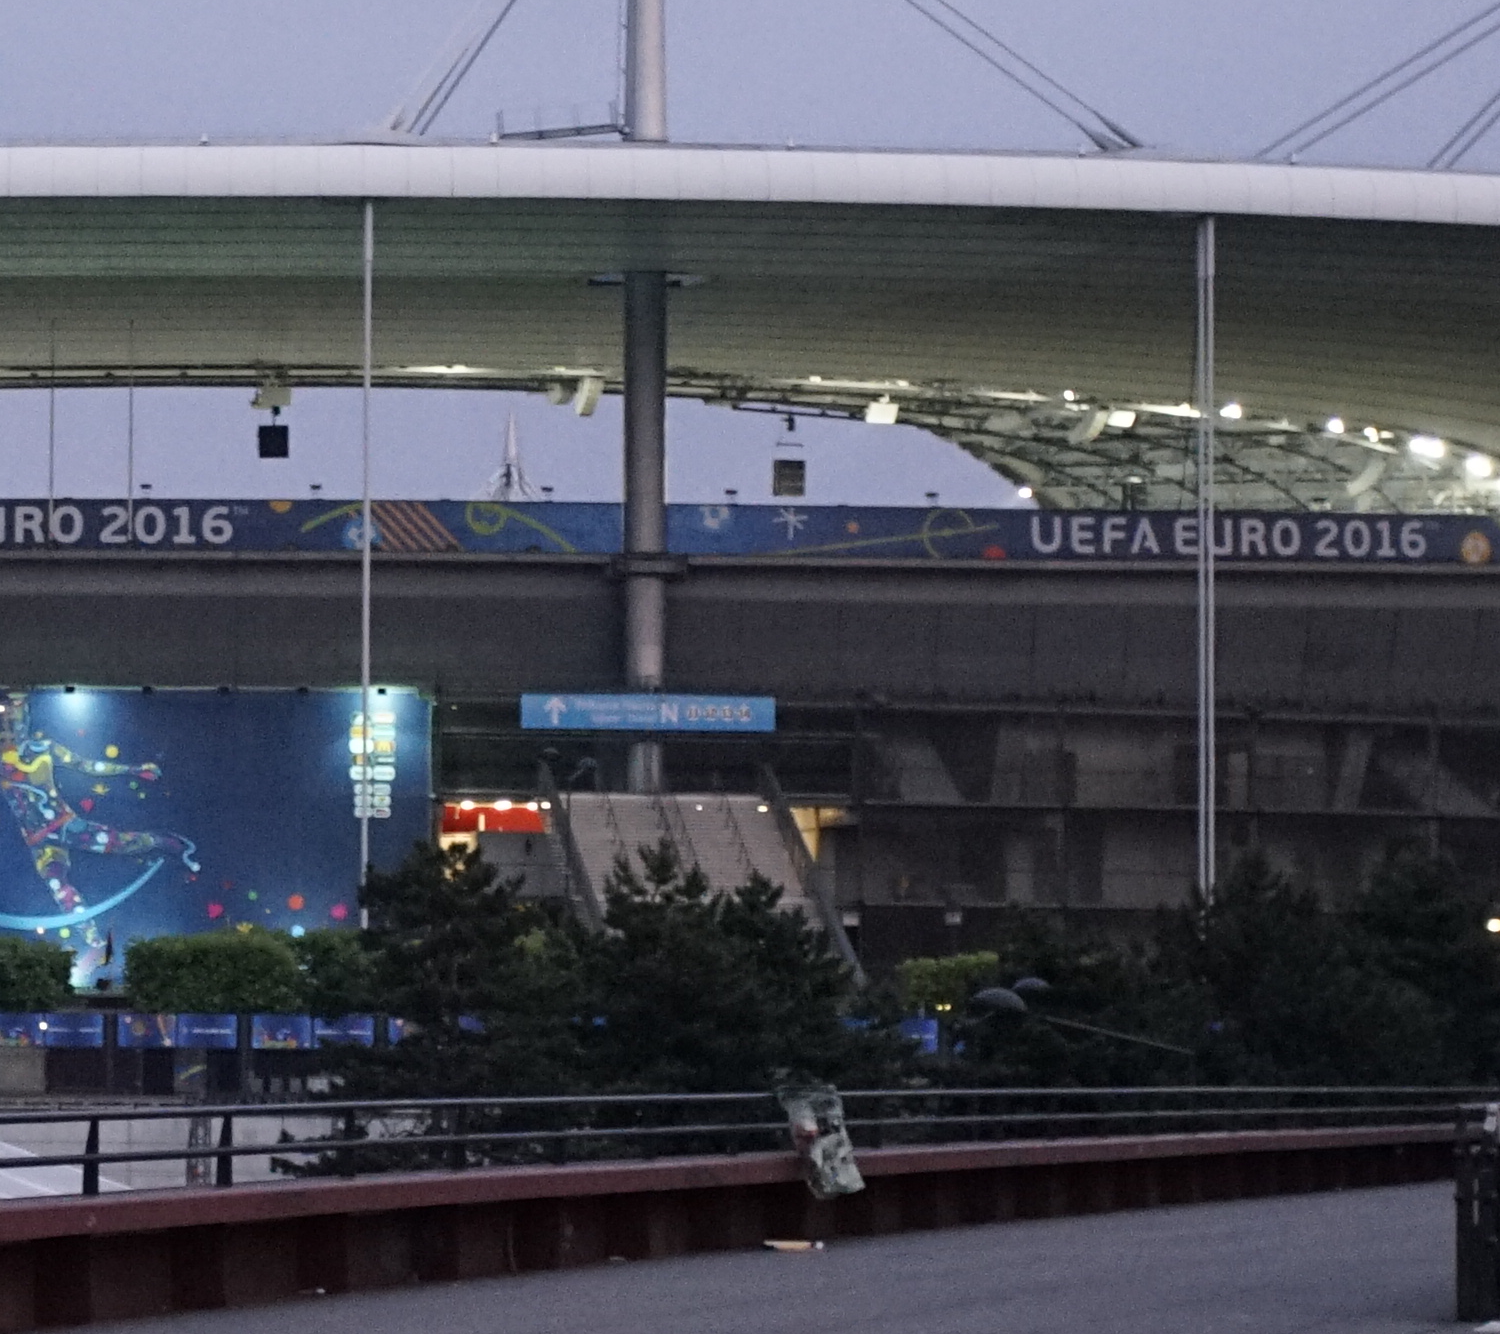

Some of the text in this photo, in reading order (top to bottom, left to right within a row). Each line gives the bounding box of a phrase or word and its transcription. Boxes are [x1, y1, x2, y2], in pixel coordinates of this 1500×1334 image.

[99, 506, 234, 545] 2016
[1030, 516, 1161, 554] UEFA
[1314, 519, 1427, 558] 2016
[660, 702, 679, 724] N
